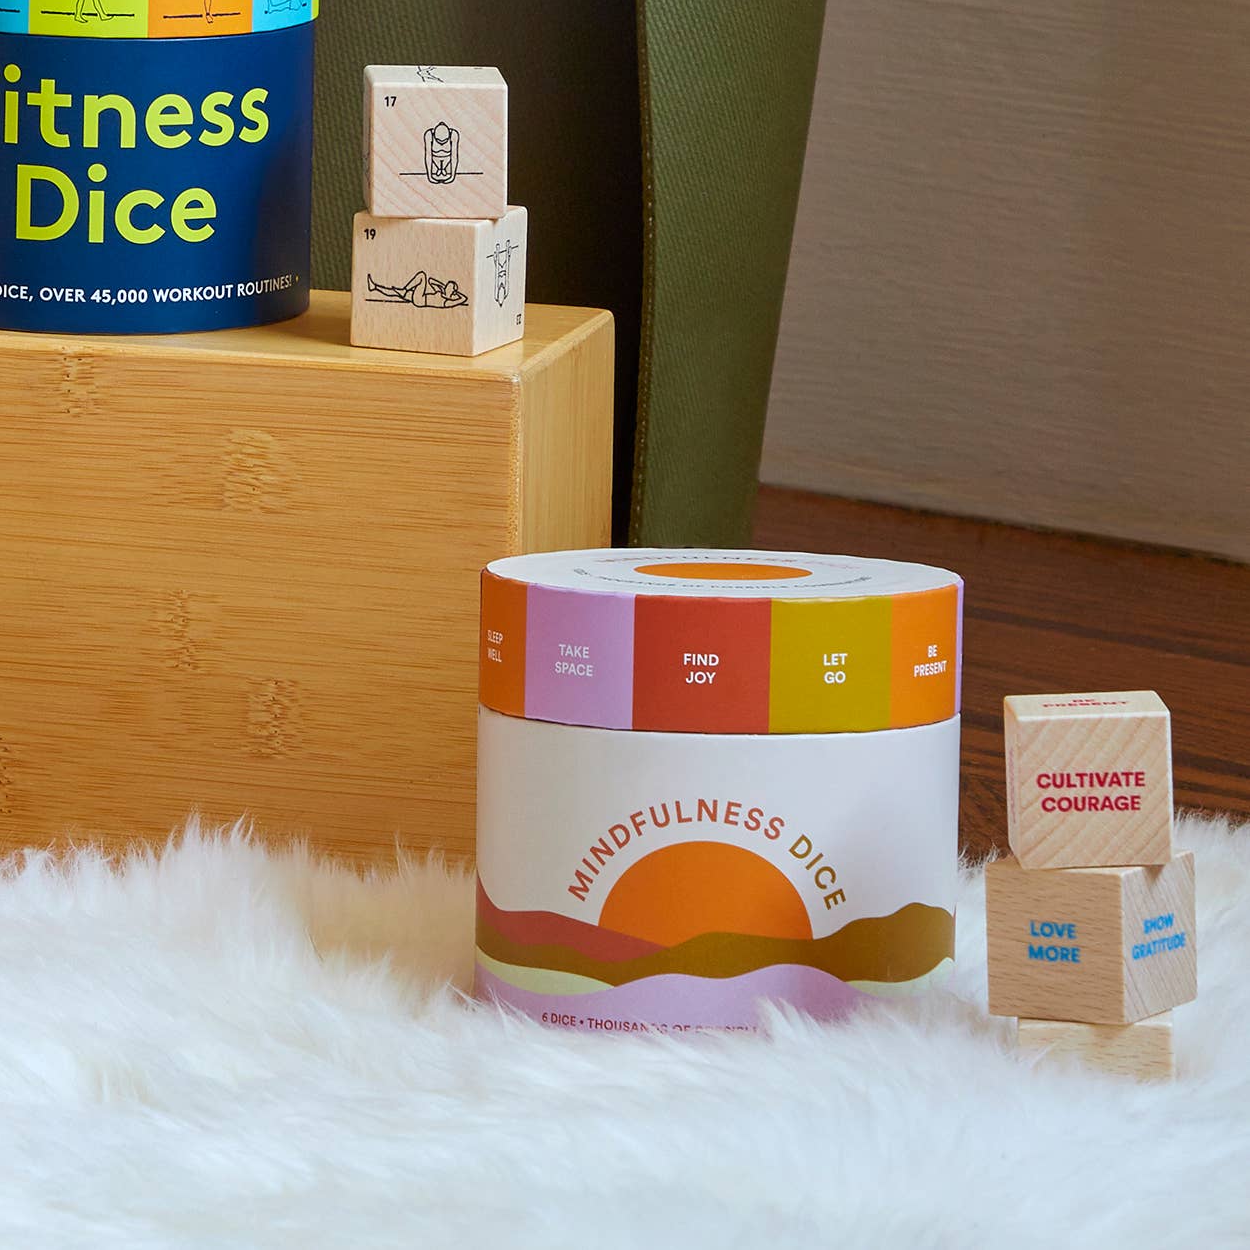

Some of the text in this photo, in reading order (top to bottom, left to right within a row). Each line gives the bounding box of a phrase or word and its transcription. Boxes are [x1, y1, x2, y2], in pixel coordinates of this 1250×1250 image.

[384, 96, 397, 107] 17
[16, 163, 217, 244] Dice
[364, 229, 376, 240] 19
[40, 287, 86, 303] OVER
[91, 289, 148, 305] 45,000
[153, 284, 233, 302] WORKOUT
[238, 274, 292, 297] ROUTINES!
[559, 643, 590, 659] TAKE
[683, 653, 719, 666] FIND
[823, 653, 848, 666] LET
[927, 645, 938, 658] BE
[554, 661, 593, 677] SPACE
[913, 660, 947, 677] PRESENT
[685, 671, 716, 684] JOY
[824, 671, 846, 684] GO
[1036, 771, 1146, 789] CULTIVATE
[1041, 795, 1141, 812] COURAGE
[568, 798, 847, 910] MINDFULNESS DICE
[1029, 920, 1077, 939] LOVE
[1143, 912, 1174, 935] SHOW
[1028, 943, 1081, 963] MORE
[1132, 931, 1185, 961] GRATITUDE
[542, 1012, 548, 1022] 6
[551, 1013, 576, 1026] DICE
[587, 1018, 668, 1034] THOUSANS
